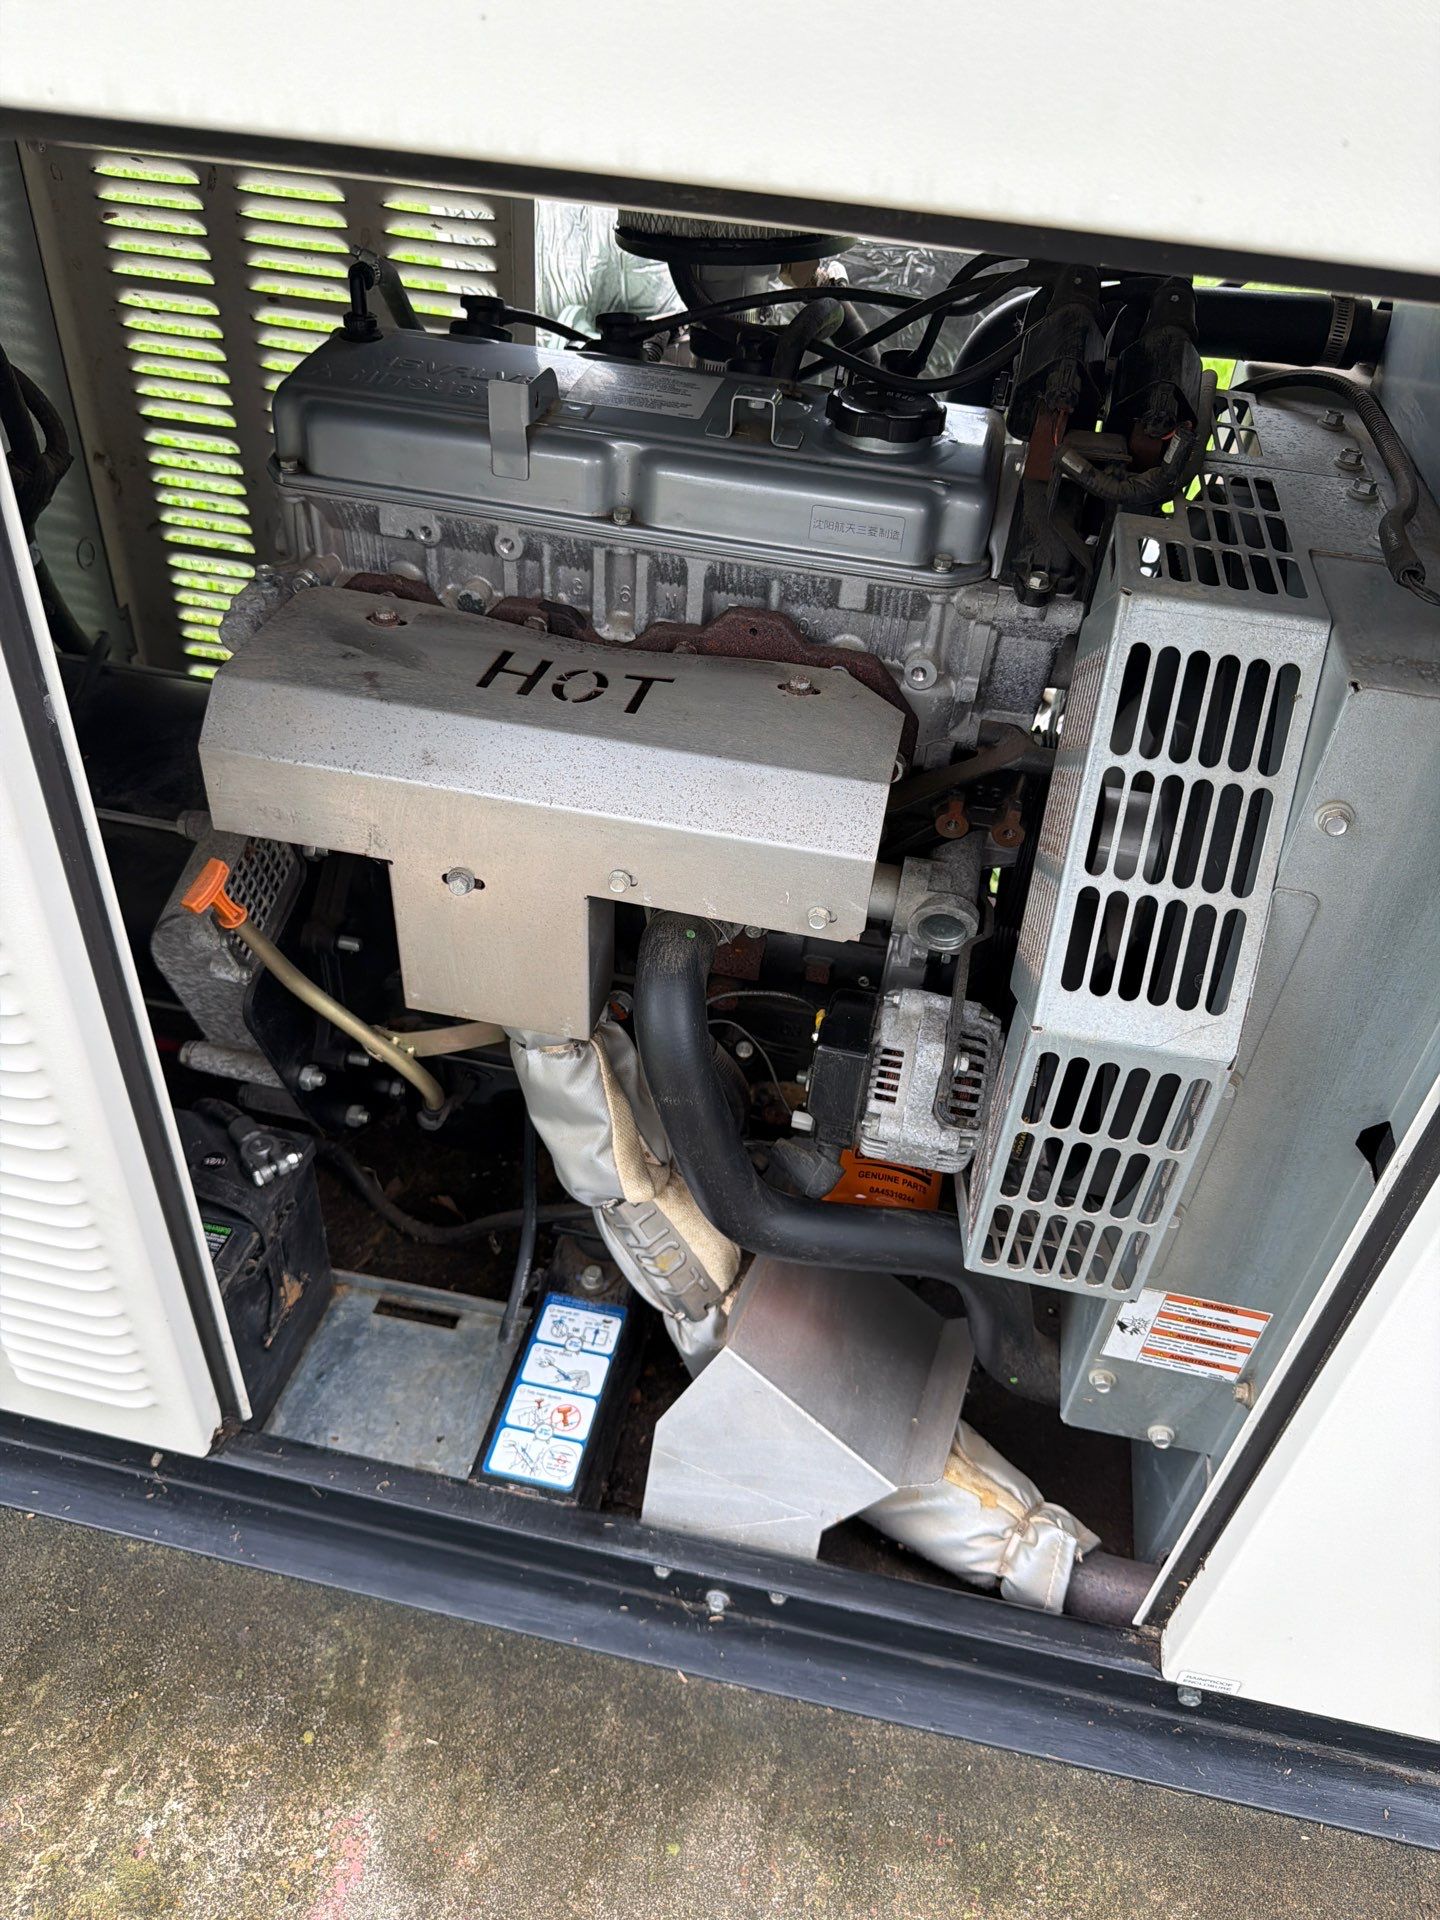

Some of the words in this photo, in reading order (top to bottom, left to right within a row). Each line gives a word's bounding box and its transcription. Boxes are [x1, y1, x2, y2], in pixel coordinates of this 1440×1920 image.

[812, 518, 901, 541] 沈阳航天三菱制造
[475, 649, 676, 715] HOT
[858, 1170, 900, 1185] GENUINE
[901, 1178, 928, 1195] PARTS
[1202, 1301, 1239, 1315] WARNING
[1186, 1317, 1239, 1333] ADVERTENCIA
[1176, 1332, 1236, 1350] AVERTISSEMENT
